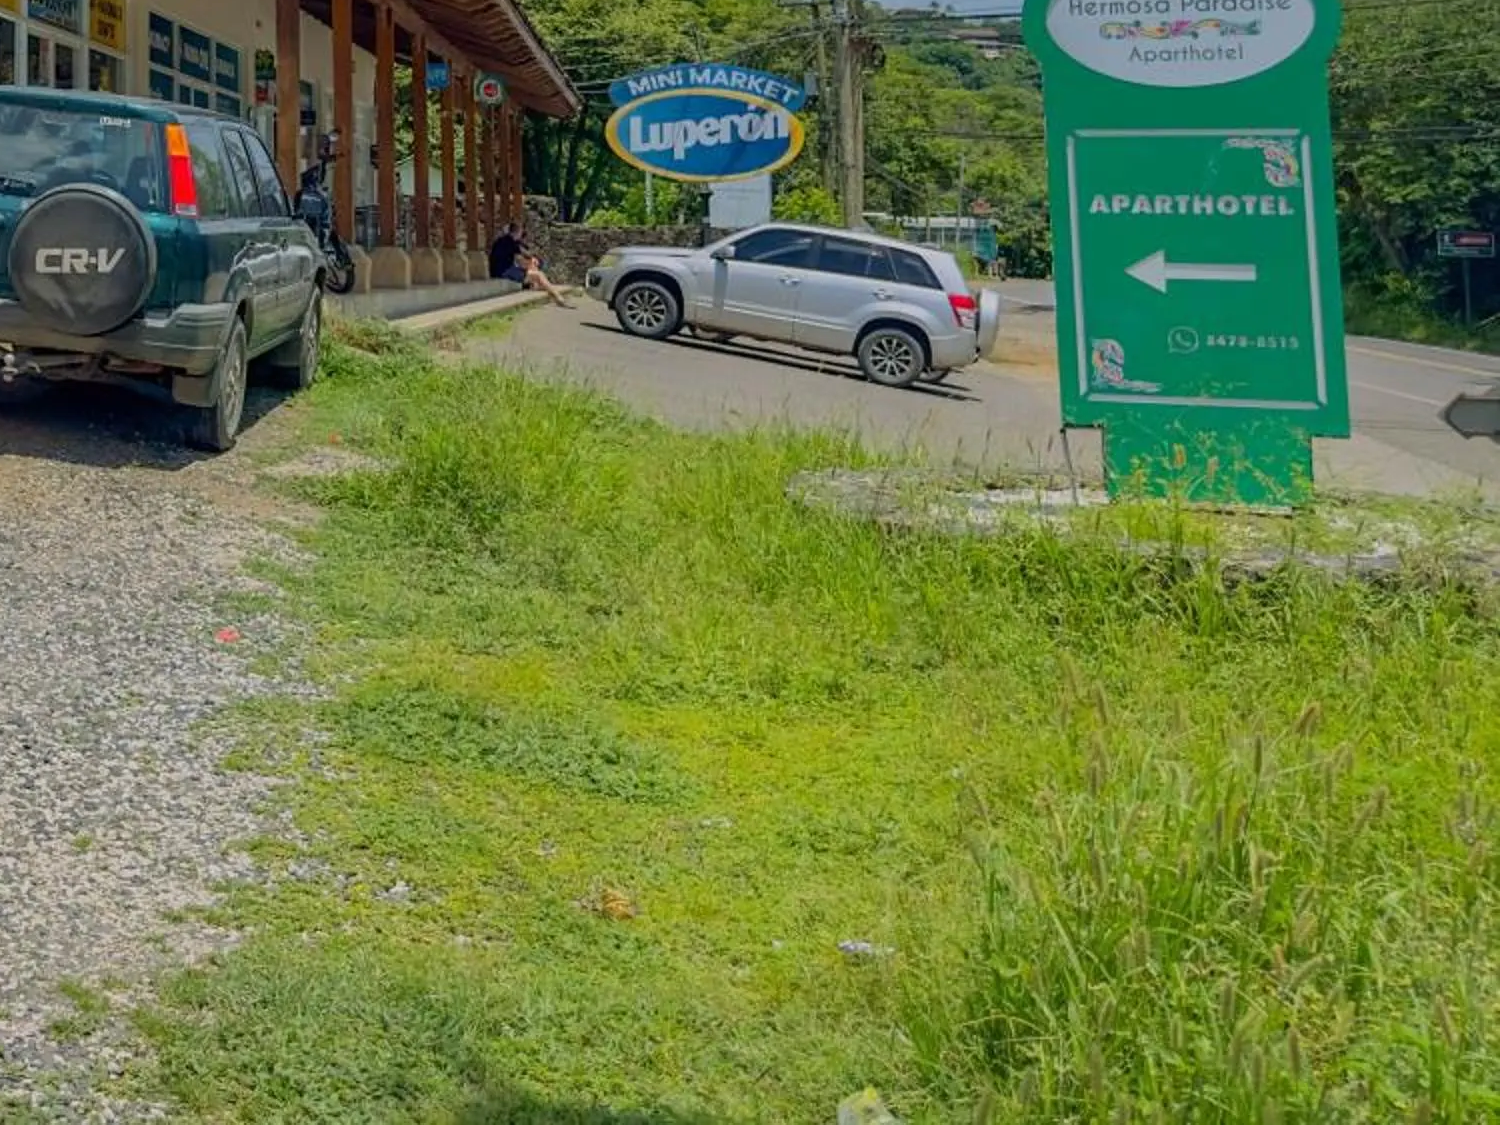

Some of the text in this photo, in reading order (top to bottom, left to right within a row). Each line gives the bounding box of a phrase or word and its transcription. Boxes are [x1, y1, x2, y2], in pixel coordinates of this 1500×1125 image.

[1128, 42, 1244, 64] Aparthotel
[627, 68, 800, 104] MINI MARKET
[629, 104, 791, 161] Luperón
[1088, 193, 1296, 216] APARTHOTEL
[35, 247, 127, 274] CR-V
